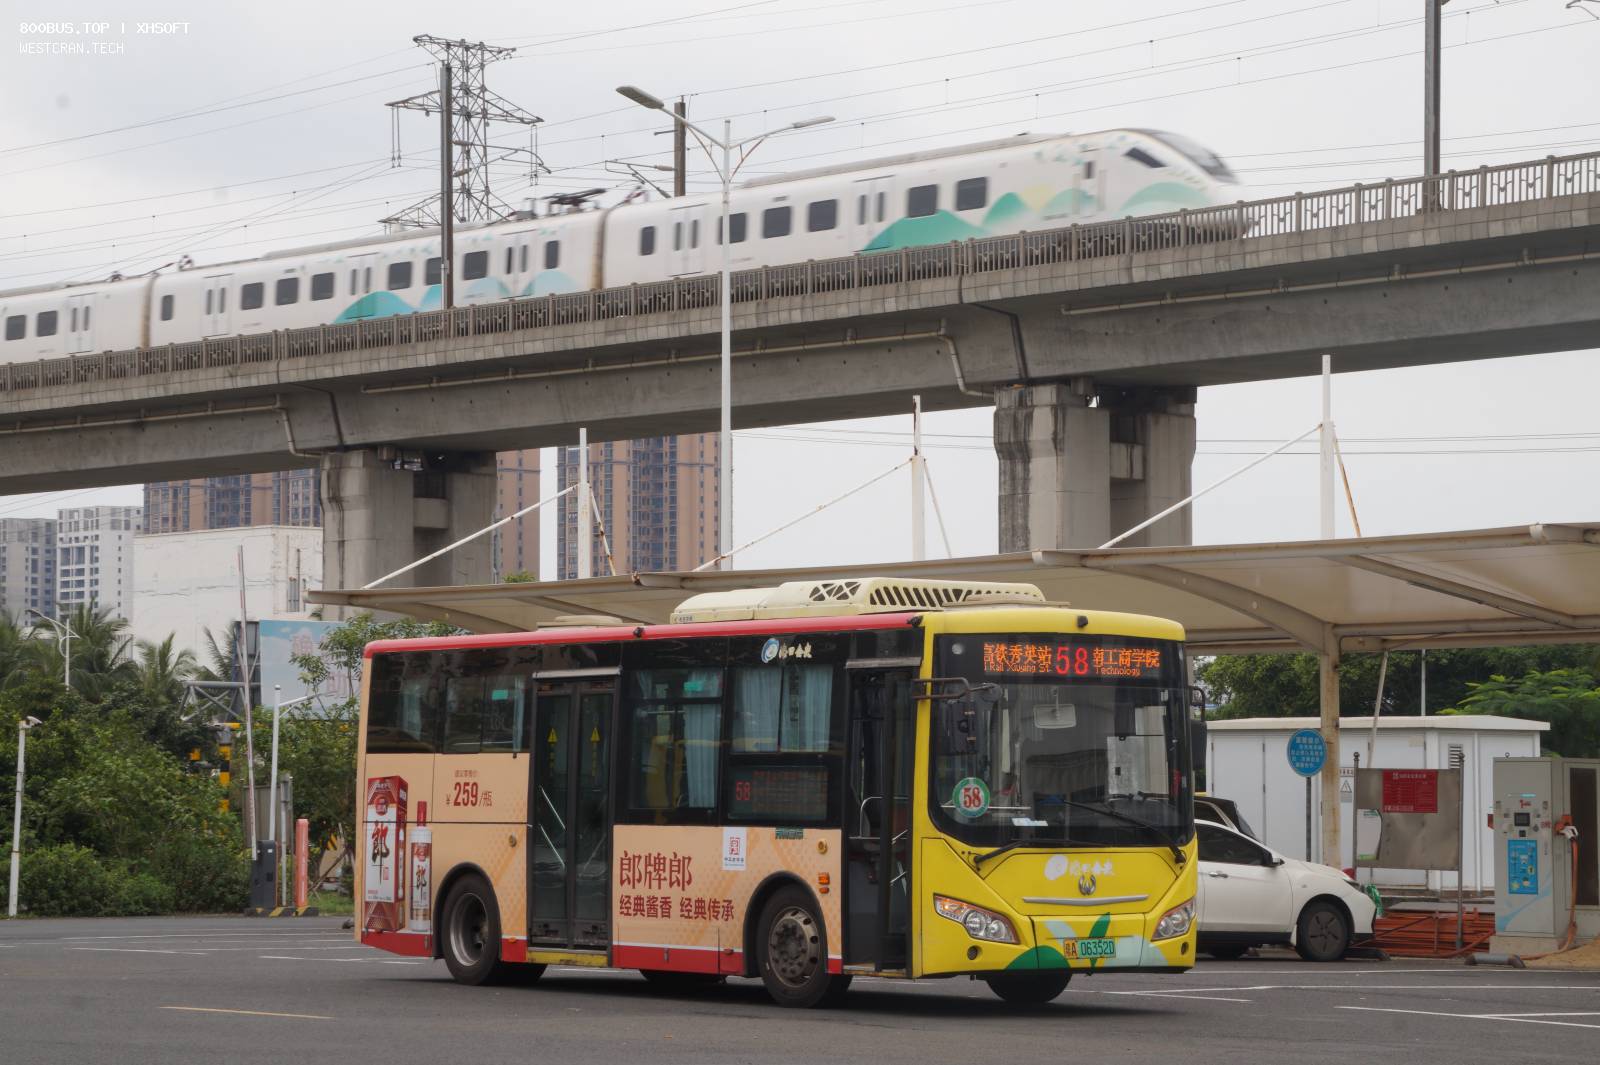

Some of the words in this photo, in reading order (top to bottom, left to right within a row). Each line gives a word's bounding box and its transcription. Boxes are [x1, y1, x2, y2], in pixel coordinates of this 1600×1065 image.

[1055, 646, 1089, 675] 58
[735, 780, 752, 801] 58
[963, 787, 981, 808] 58
[619, 849, 692, 891] 郎牌郎
[619, 894, 673, 919] 经典酱香
[680, 897, 735, 922] 经典传承
